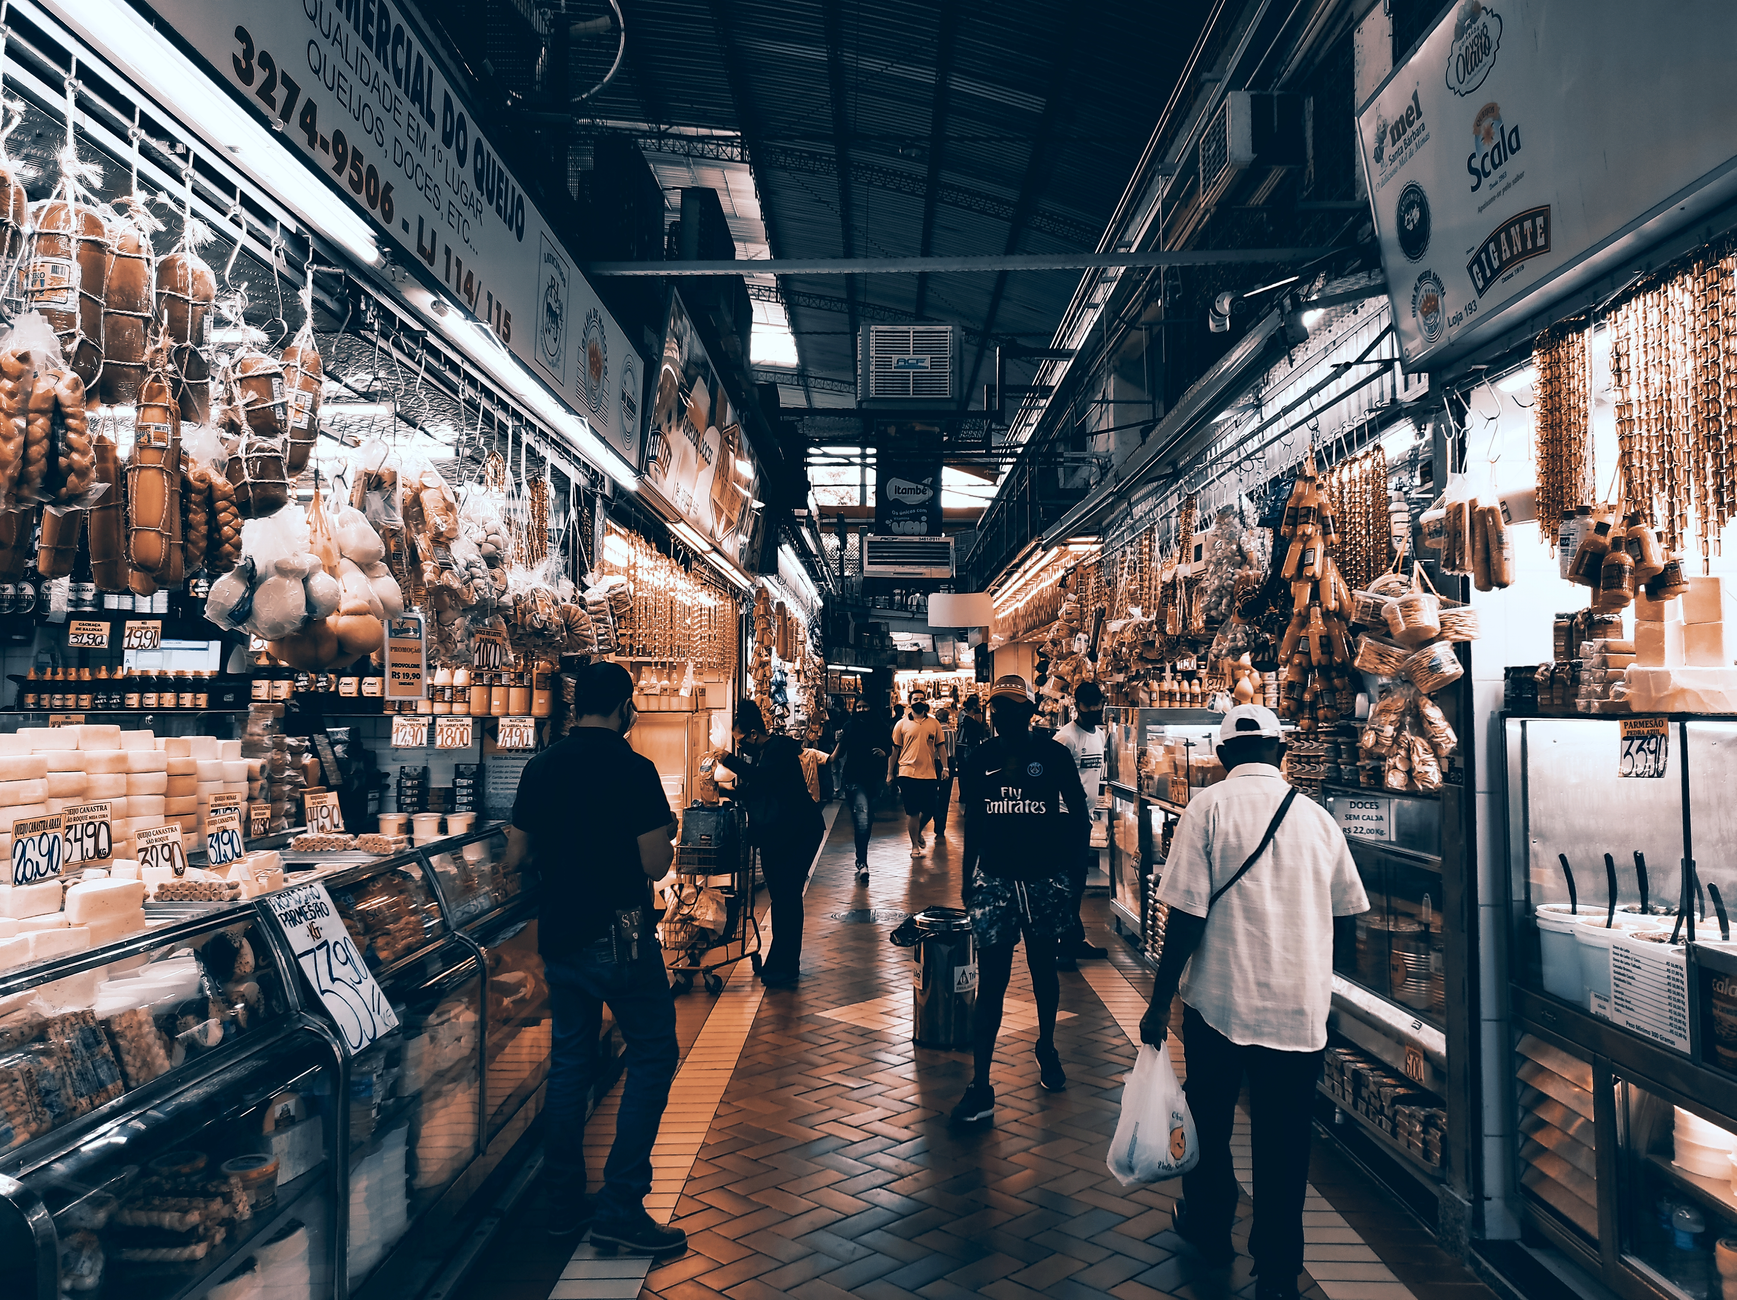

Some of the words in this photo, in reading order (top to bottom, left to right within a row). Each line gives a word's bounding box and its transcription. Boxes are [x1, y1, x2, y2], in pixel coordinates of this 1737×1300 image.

[303, 0, 402, 129] QUALIDADE
[406, 110, 427, 157] EM
[444, 158, 484, 227] LUGAR
[1389, 88, 1423, 148] mel
[231, 24, 395, 225] 3274-9506
[416, 214, 437, 268] LJ
[306, 39, 389, 159] QUEIJOS,
[393, 136, 444, 221] DOCES,
[447, 199, 479, 256] ETC...
[1388, 146, 1404, 167] Santa
[442, 90, 469, 169] DO
[473, 136, 526, 243] QUEIJO
[1466, 123, 1522, 193] Scala
[1471, 215, 1546, 290] GIGANTE
[1447, 308, 1464, 329] Loja
[1463, 299, 1478, 318] 193
[390, 646, 422, 655] PROMOÇÃO
[391, 671, 401, 680] R$
[402, 672, 421, 681] 19,90
[1623, 719, 1664, 730] PARMESÃO
[1646, 728, 1661, 736] AZUL
[1000, 786, 1022, 800] Fly
[79, 803, 109, 815] CANASTRA
[1349, 800, 1380, 810] DOCES
[14, 820, 29, 839] QUEIJO
[28, 816, 49, 834] CANASTRA
[1344, 813, 1361, 821] SEM
[136, 829, 153, 841] QUEIJO
[152, 825, 178, 839] CANASTRA
[1342, 826, 1352, 835] R$
[277, 901, 331, 929] PARMESÃO
